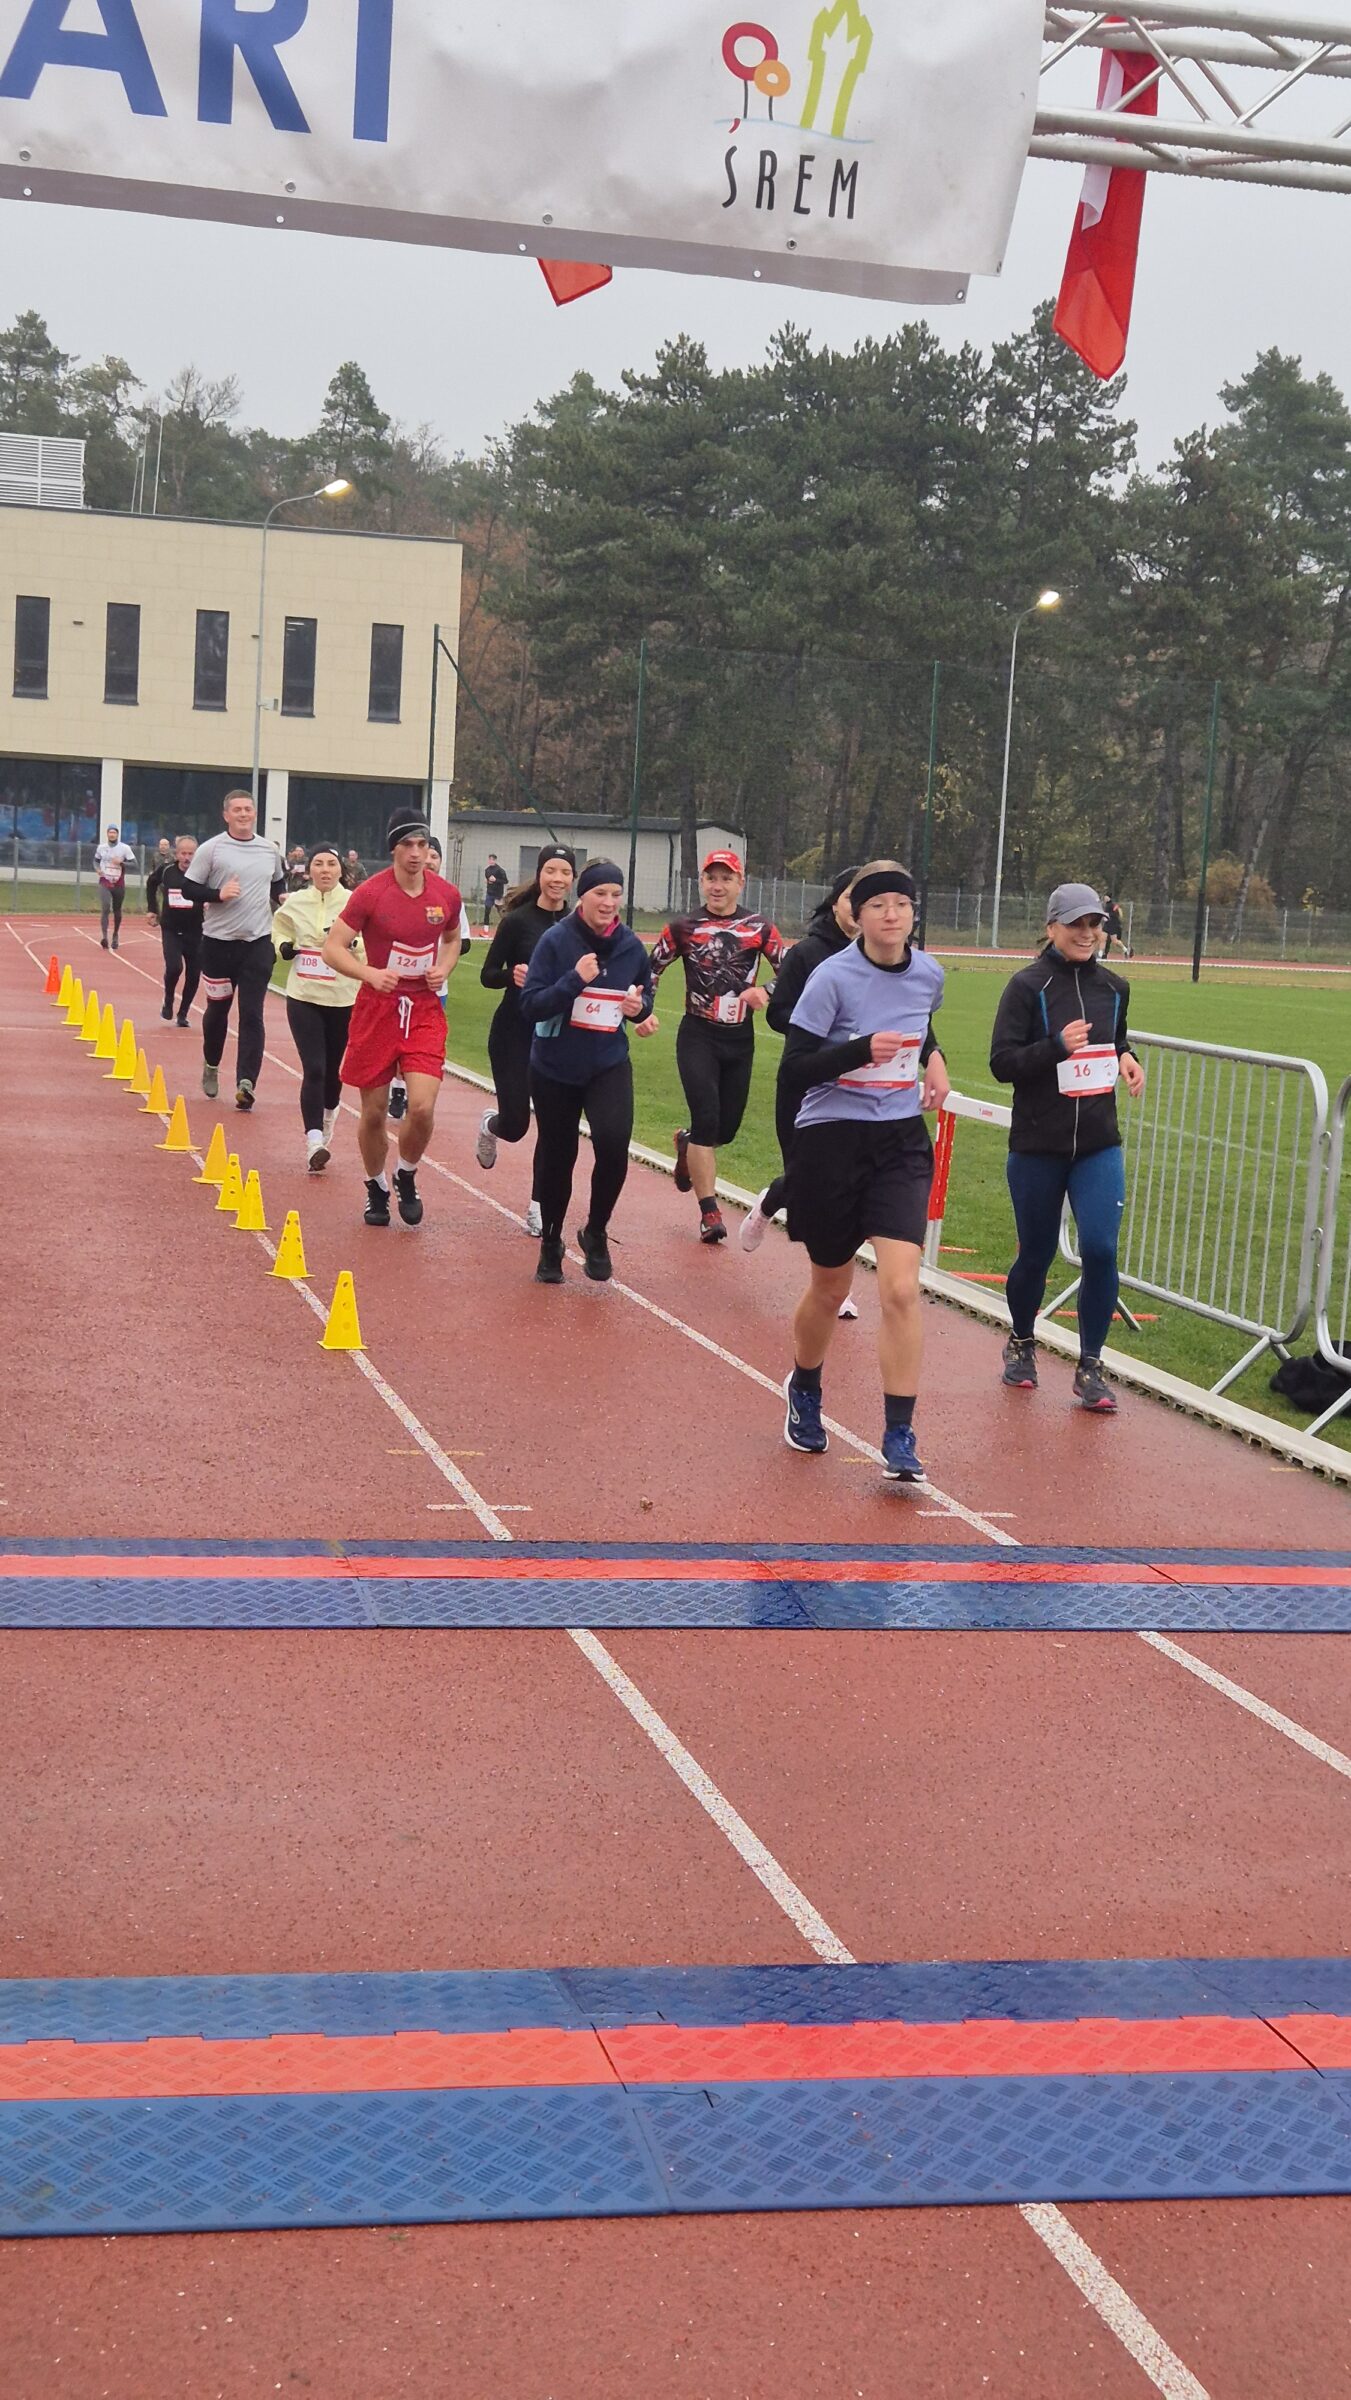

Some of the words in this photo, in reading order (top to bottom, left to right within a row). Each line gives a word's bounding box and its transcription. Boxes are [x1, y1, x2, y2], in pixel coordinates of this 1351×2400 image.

[722, 118, 858, 219] ŚREM
[302, 957, 318, 967] 108
[396, 956, 418, 968] 124
[585, 1002, 600, 1015] 64
[727, 1003, 737, 1022] 191
[1073, 1063, 1091, 1078] 16
